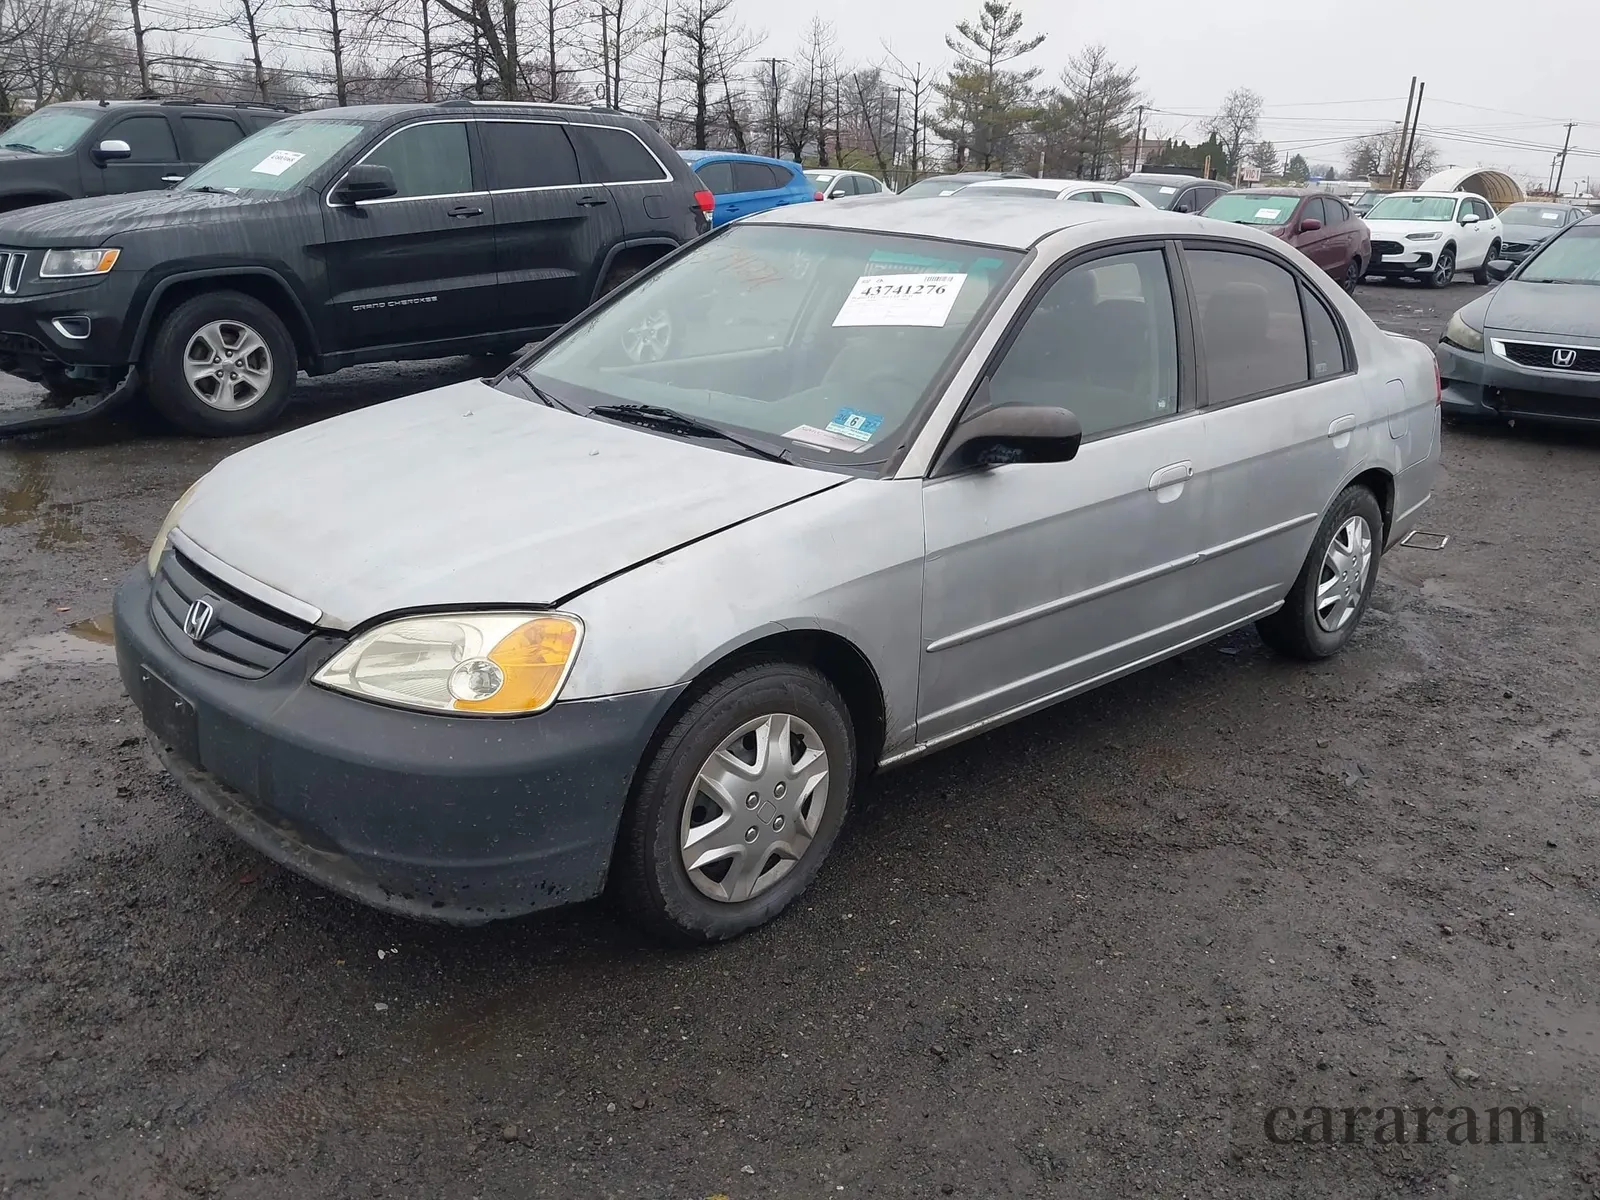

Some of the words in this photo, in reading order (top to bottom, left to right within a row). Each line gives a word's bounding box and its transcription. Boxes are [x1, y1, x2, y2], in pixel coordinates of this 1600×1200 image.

[861, 284, 947, 296] 43741276
[352, 302, 386, 311] GRAND
[387, 296, 438, 307] CHEROKEE
[849, 417, 859, 427] 6
